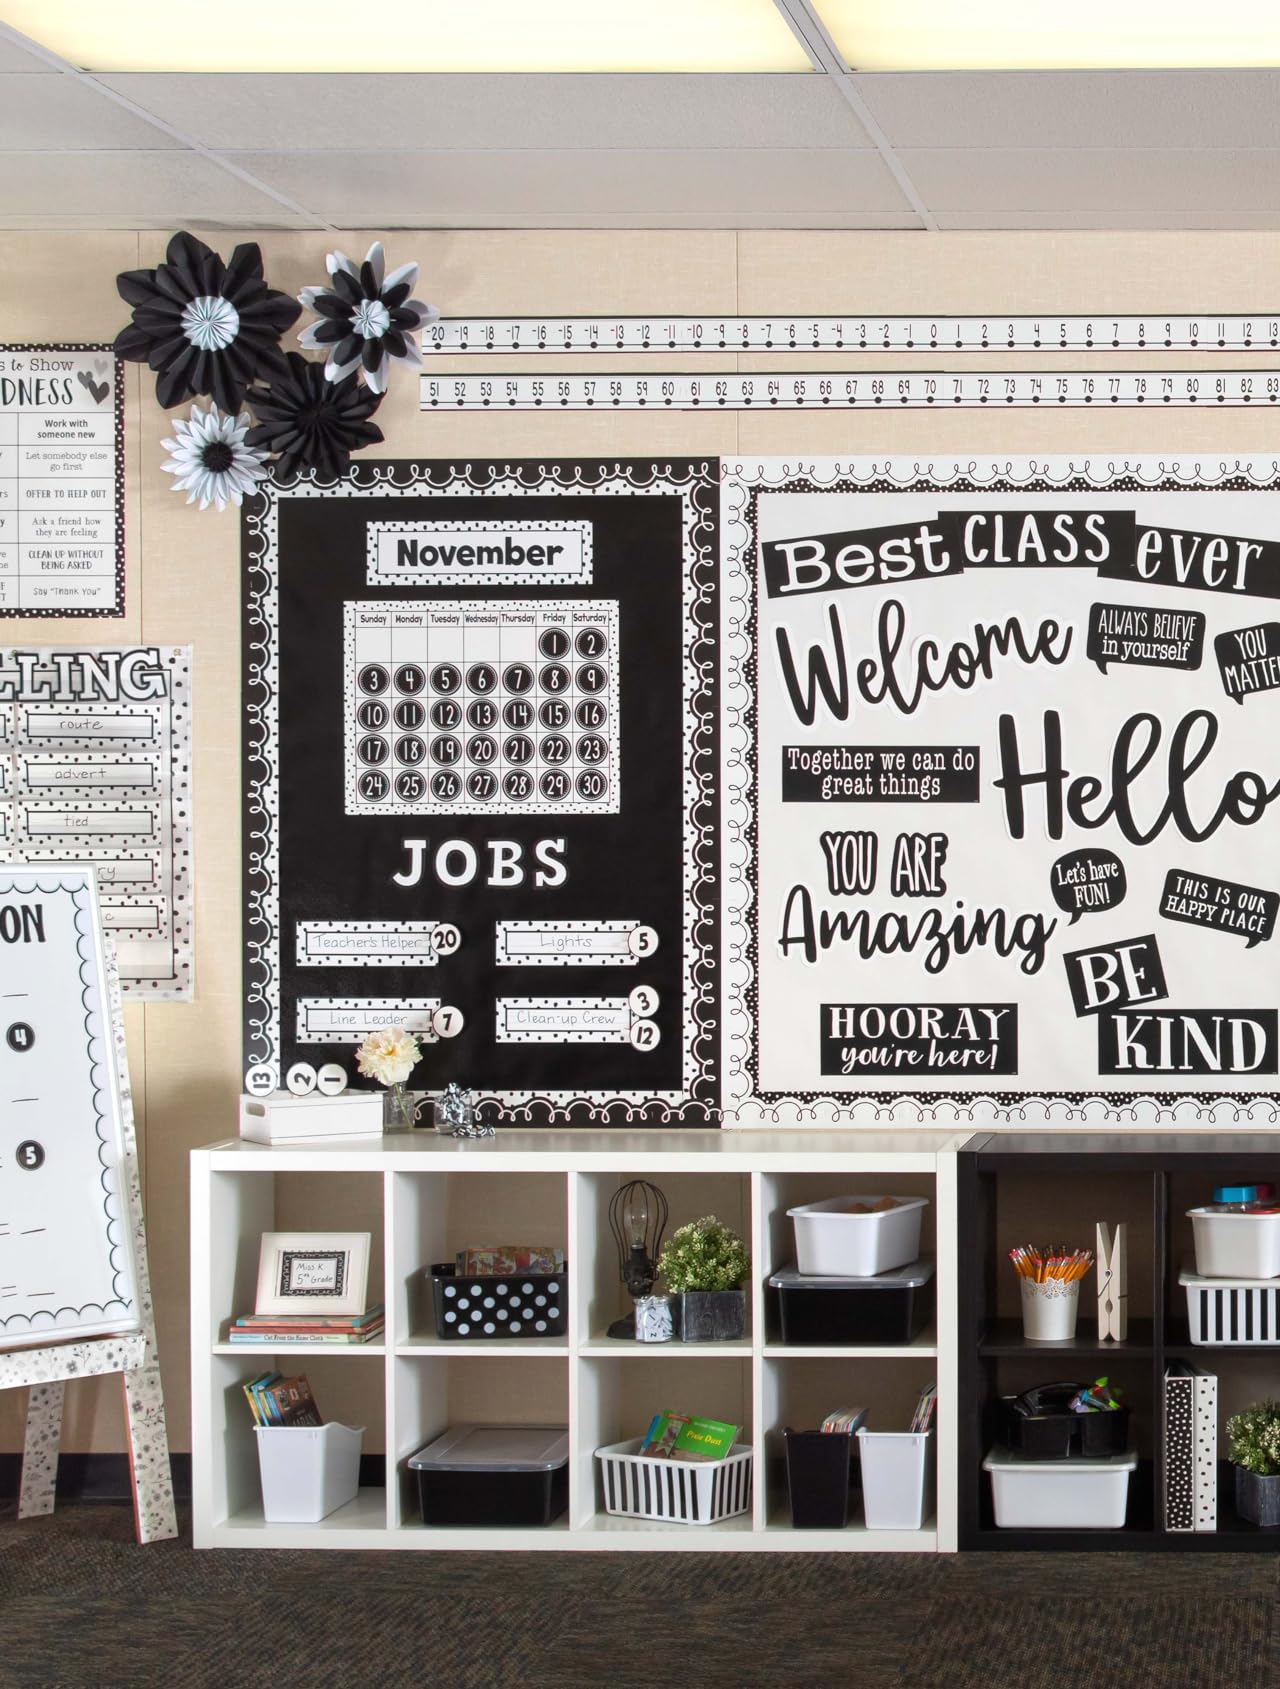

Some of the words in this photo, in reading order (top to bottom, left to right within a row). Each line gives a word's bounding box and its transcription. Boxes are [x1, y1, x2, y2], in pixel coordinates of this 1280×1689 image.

[426, 326, 444, 341] -20
[480, 326, 494, 340] -18
[931, 324, 937, 338] 0
[982, 324, 988, 338] 2
[30, 359, 74, 371] Show
[430, 382, 439, 396] 51
[455, 382, 466, 396] 52
[716, 381, 727, 395] 62
[45, 419, 67, 427] Work
[69, 419, 88, 427] with
[26, 490, 51, 498] OFFER
[55, 490, 64, 498] TO
[68, 490, 88, 498] HELP
[91, 490, 107, 498] OUT
[964, 513, 1111, 564] CLASS
[397, 537, 564, 566] November
[775, 526, 951, 592] Best
[1136, 529, 1264, 590] ever
[360, 614, 387, 625] Sunday
[395, 614, 423, 625] Monday
[430, 614, 460, 625] Tuesday
[465, 614, 499, 624] Wednesday
[502, 614, 535, 624] Thursday
[543, 614, 566, 624] Friday
[573, 613, 607, 624] Saturday
[1098, 609, 1149, 636] ALWAYS
[1153, 613, 1197, 641] BELIEVE
[587, 634, 596, 654] 2
[1101, 637, 1116, 658] in
[1117, 639, 1191, 663] yourself
[1235, 632, 1268, 660] YOU
[775, 599, 1073, 726] Welcome
[369, 671, 378, 689] 3
[441, 670, 450, 689] 5
[514, 670, 523, 688] 7
[587, 670, 596, 688] 9
[59, 718, 104, 730] route
[366, 706, 382, 725] 10
[476, 706, 491, 724] 13
[787, 747, 875, 774] Together
[880, 753, 907, 770] we
[913, 753, 948, 770] can
[953, 748, 975, 770] do
[55, 769, 107, 780] advert
[366, 777, 382, 795] 24
[583, 775, 599, 793] 30
[822, 778, 874, 798] great
[879, 774, 941, 798] things
[64, 815, 89, 827] tied
[392, 838, 567, 888] JOBS
[825, 835, 873, 893] YOU
[896, 835, 944, 893] ARE
[1057, 863, 1086, 886] Let's
[1086, 859, 1119, 881] have
[1074, 883, 1112, 909] FUN!
[1176, 876, 1209, 899] THIS
[1214, 886, 1232, 904] IS
[1238, 891, 1266, 914] OUR
[1165, 894, 1219, 923] HAPPY
[1221, 907, 1268, 935] PLACE
[778, 884, 1058, 975] Amazing
[312, 933, 377, 948] Teacher's
[381, 935, 424, 952] Helper
[434, 930, 457, 949] 20
[541, 933, 592, 951] Lights
[639, 932, 649, 950] 5
[1075, 943, 1158, 1010] BE
[637, 992, 650, 1010] 3
[330, 1012, 356, 1024] Line
[364, 1012, 408, 1025] Leader
[442, 1013, 452, 1031] 7
[517, 1011, 577, 1025] Clean-up
[583, 1011, 615, 1024] Crew
[828, 1006, 1011, 1041] HOORAY
[15, 1028, 27, 1046] 4
[637, 1027, 653, 1045] 12
[1111, 1014, 1266, 1072] KIND
[841, 1044, 923, 1074] you're
[928, 1040, 997, 1071] here!
[25, 1146, 36, 1164] 5
[296, 1263, 315, 1271] Miss
[687, 1430, 703, 1441] Pixie
[704, 1434, 722, 1446] Dust
